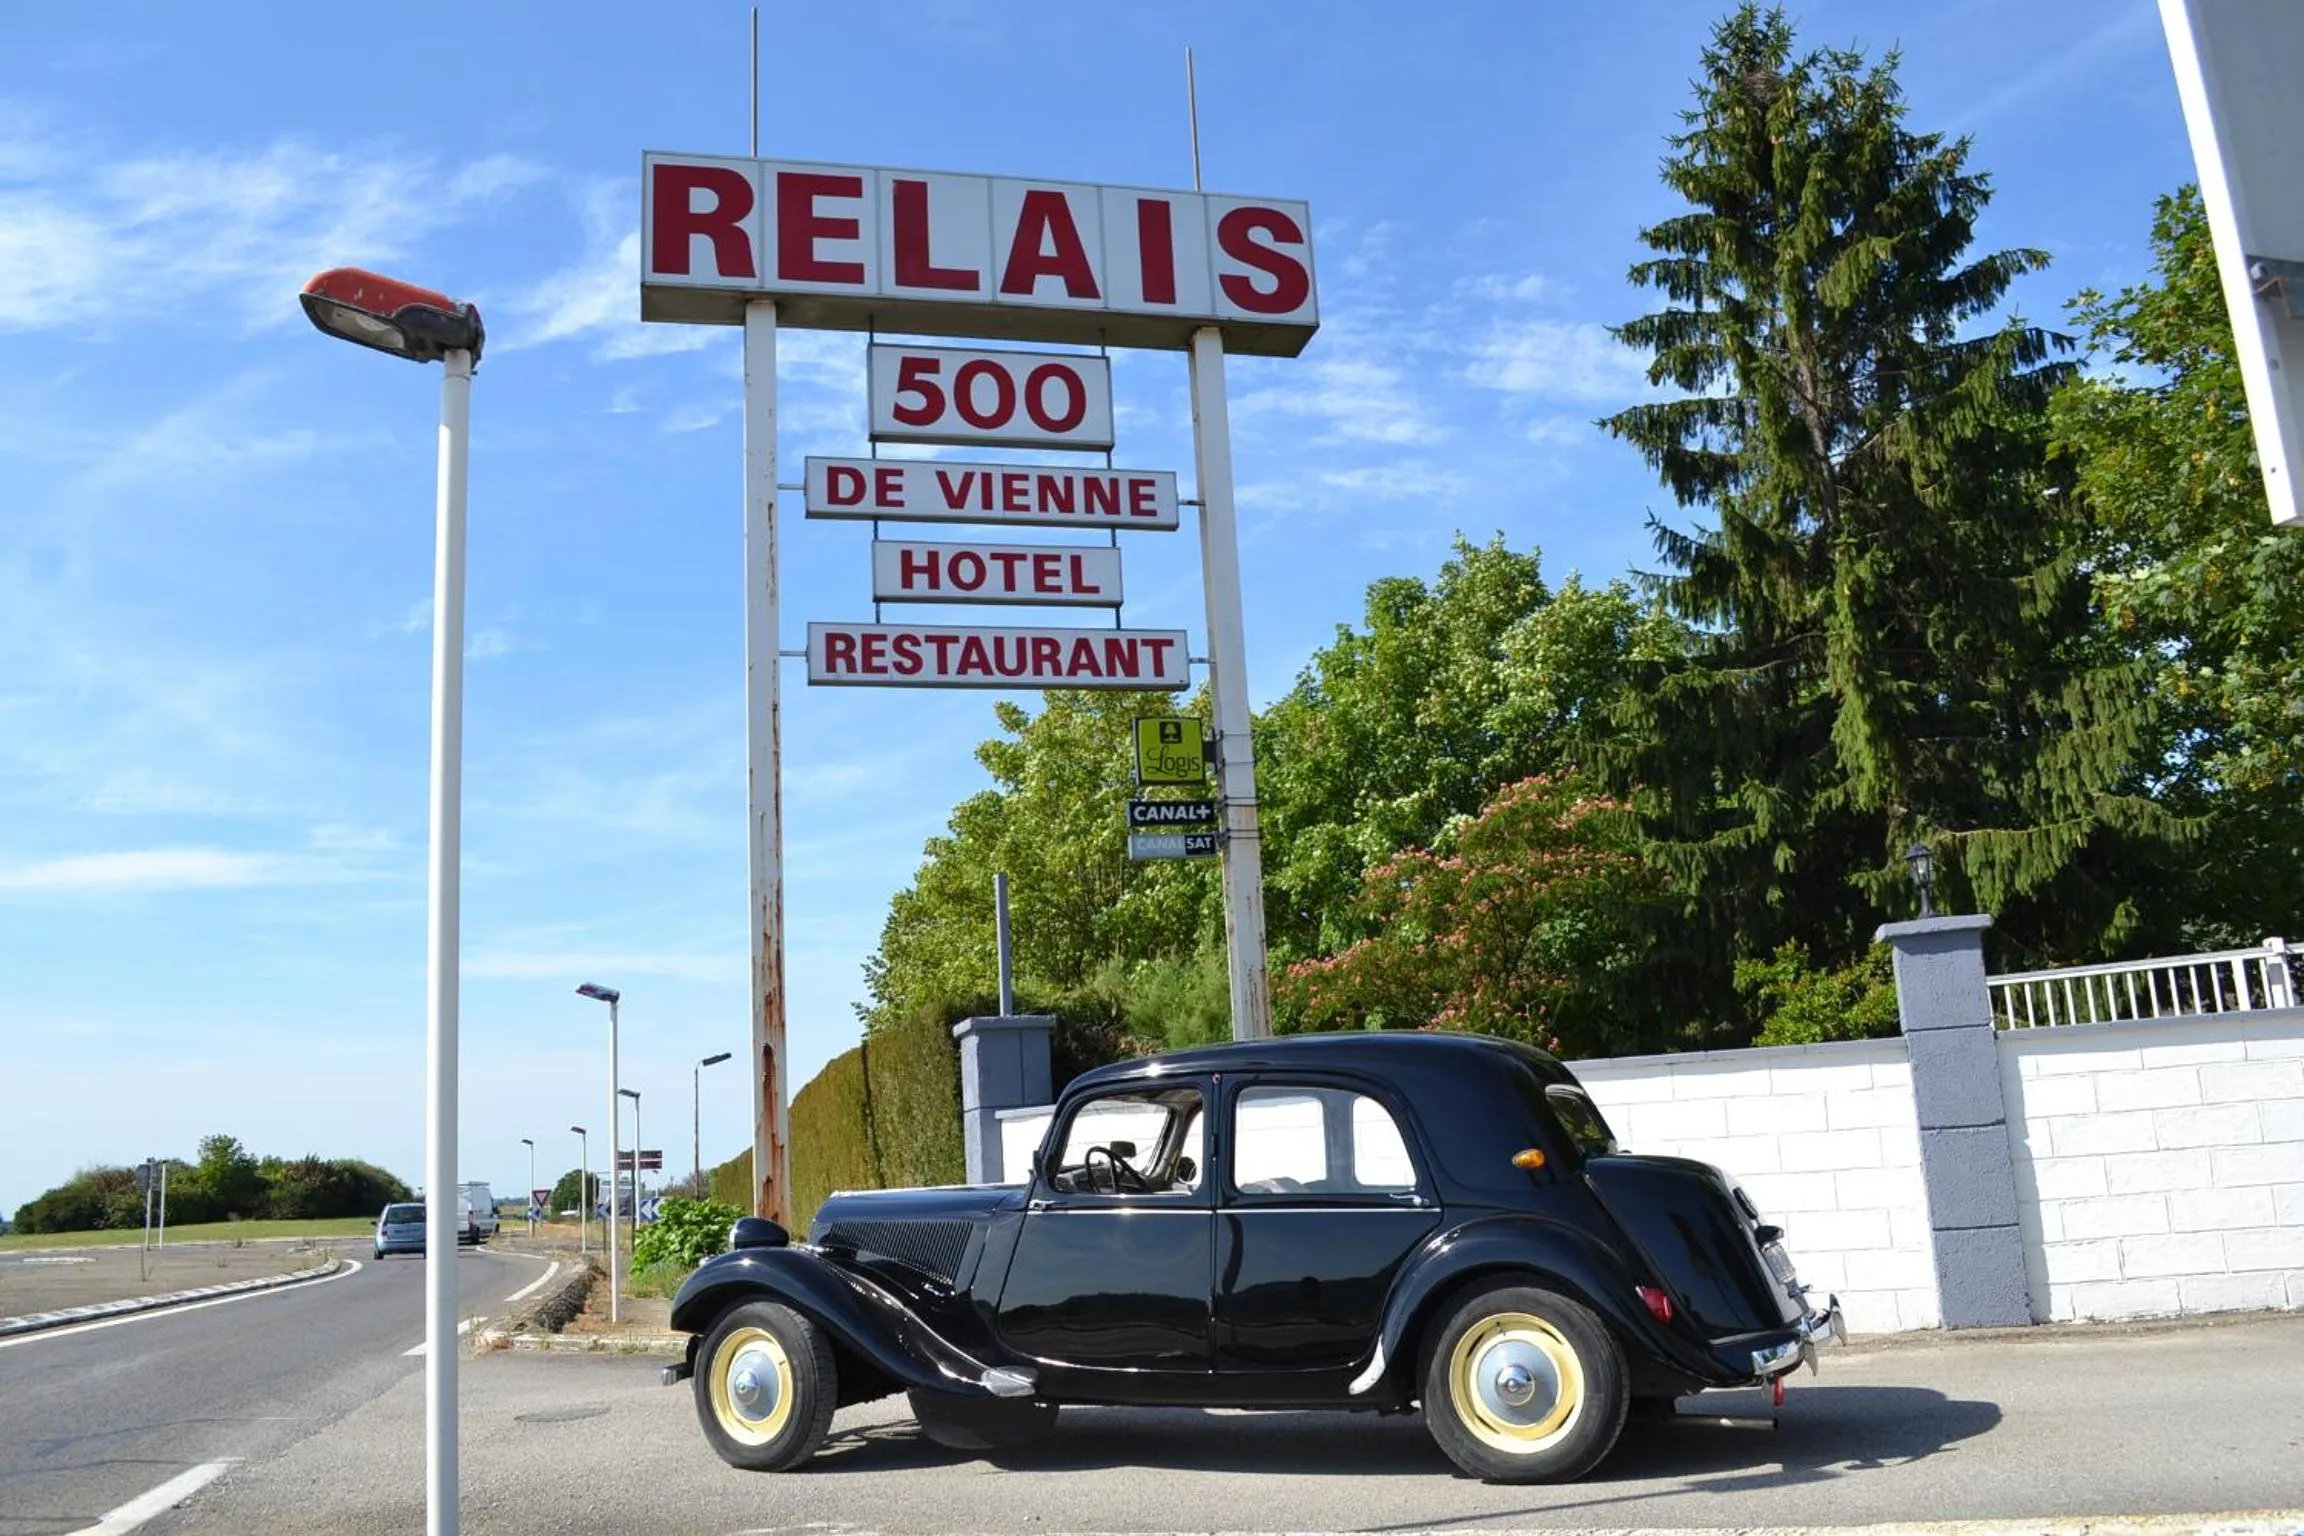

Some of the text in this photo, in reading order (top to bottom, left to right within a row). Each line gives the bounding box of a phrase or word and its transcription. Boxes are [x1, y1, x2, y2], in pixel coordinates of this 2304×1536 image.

[652, 163, 1310, 314] RELAIS
[892, 356, 1087, 433] 500
[826, 466, 1158, 517] DE VIENNE
[900, 549, 1100, 594] HOTEL
[825, 632, 1175, 678] RESTAURANT
[1145, 745, 1200, 778] Logis
[1133, 804, 1211, 821] CANAL+
